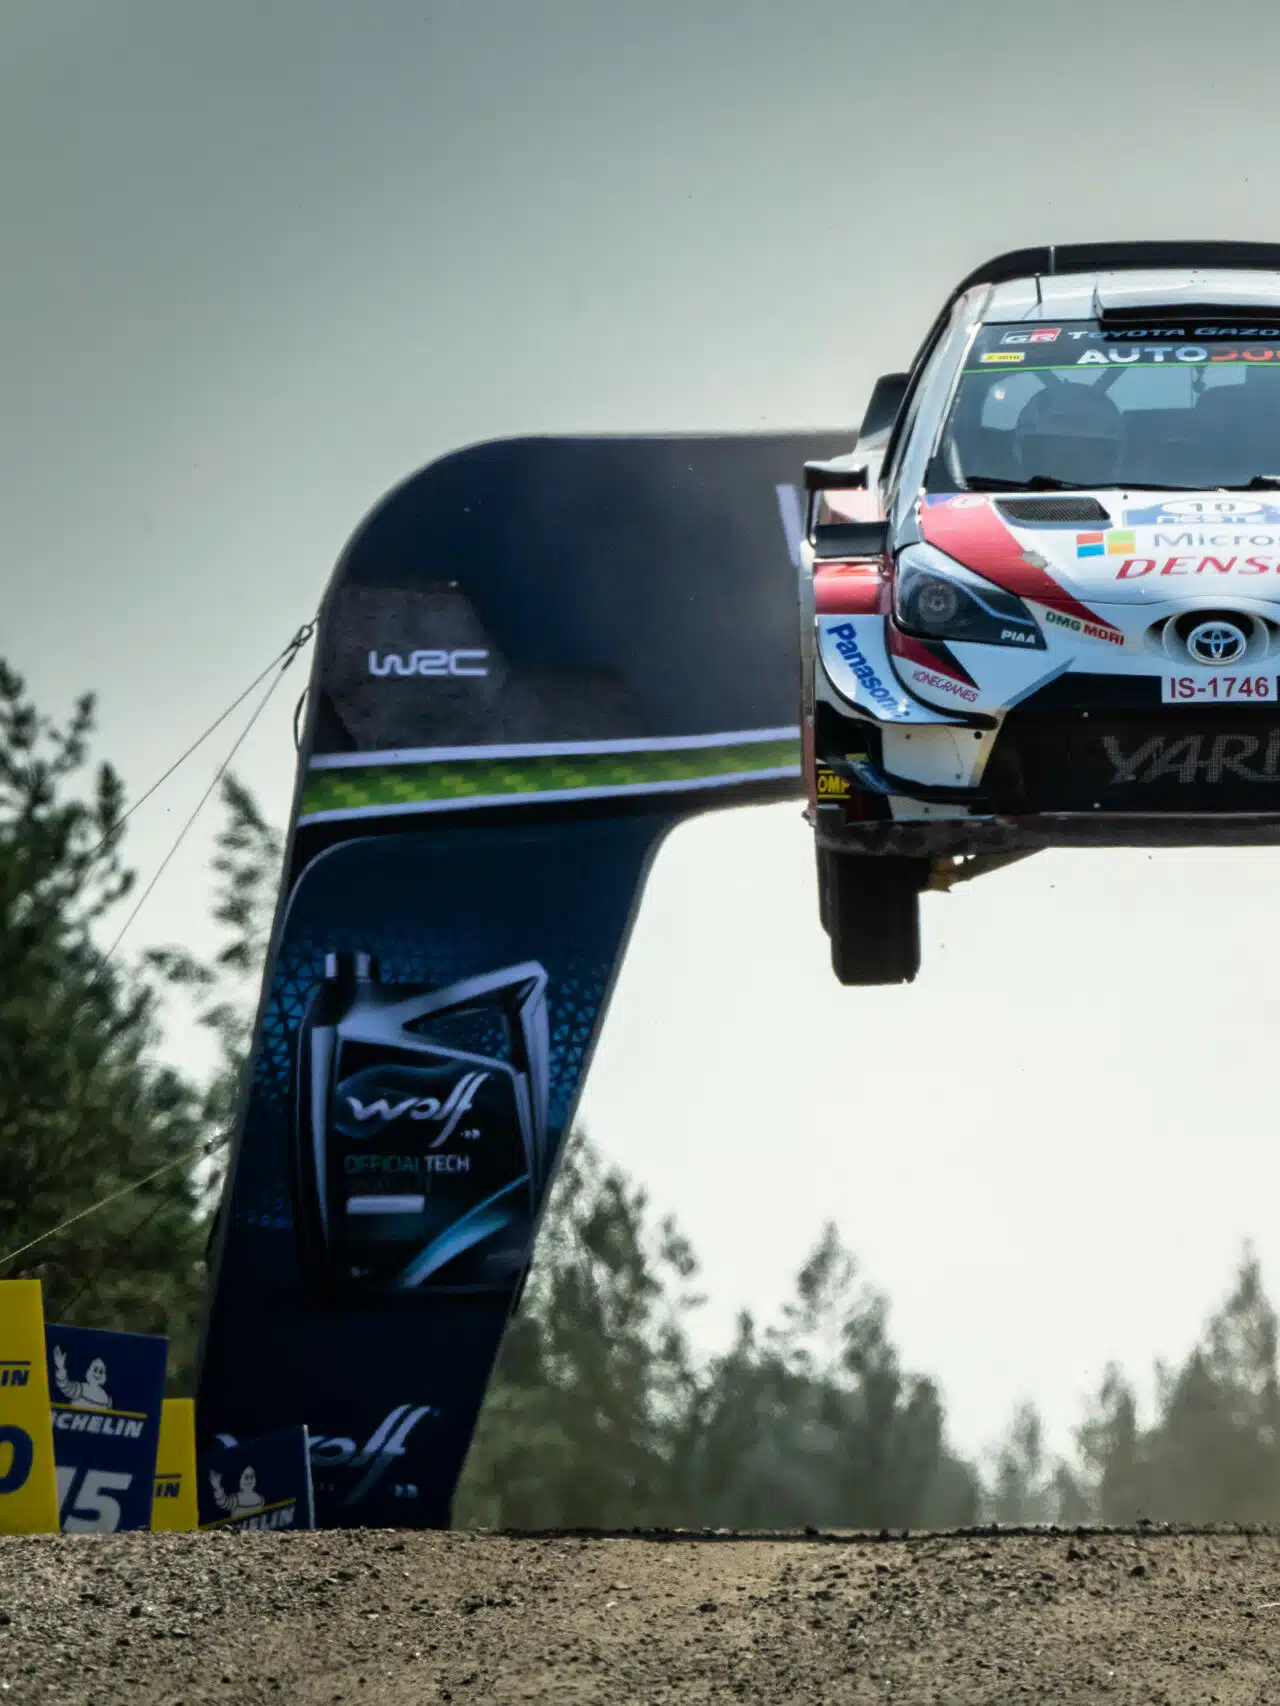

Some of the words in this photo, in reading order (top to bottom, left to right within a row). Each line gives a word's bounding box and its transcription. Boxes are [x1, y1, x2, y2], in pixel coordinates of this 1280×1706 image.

[1003, 329, 1060, 343] GR
[1068, 329, 1185, 340] TOYOTA
[1001, 629, 1036, 645] PIAA
[1045, 610, 1081, 632] DMG
[1083, 624, 1125, 646] MORI
[368, 649, 490, 677] WRC
[1170, 677, 1270, 698] IS-1746
[347, 1071, 491, 1149] wolf
[424, 1154, 470, 1173] TECH
